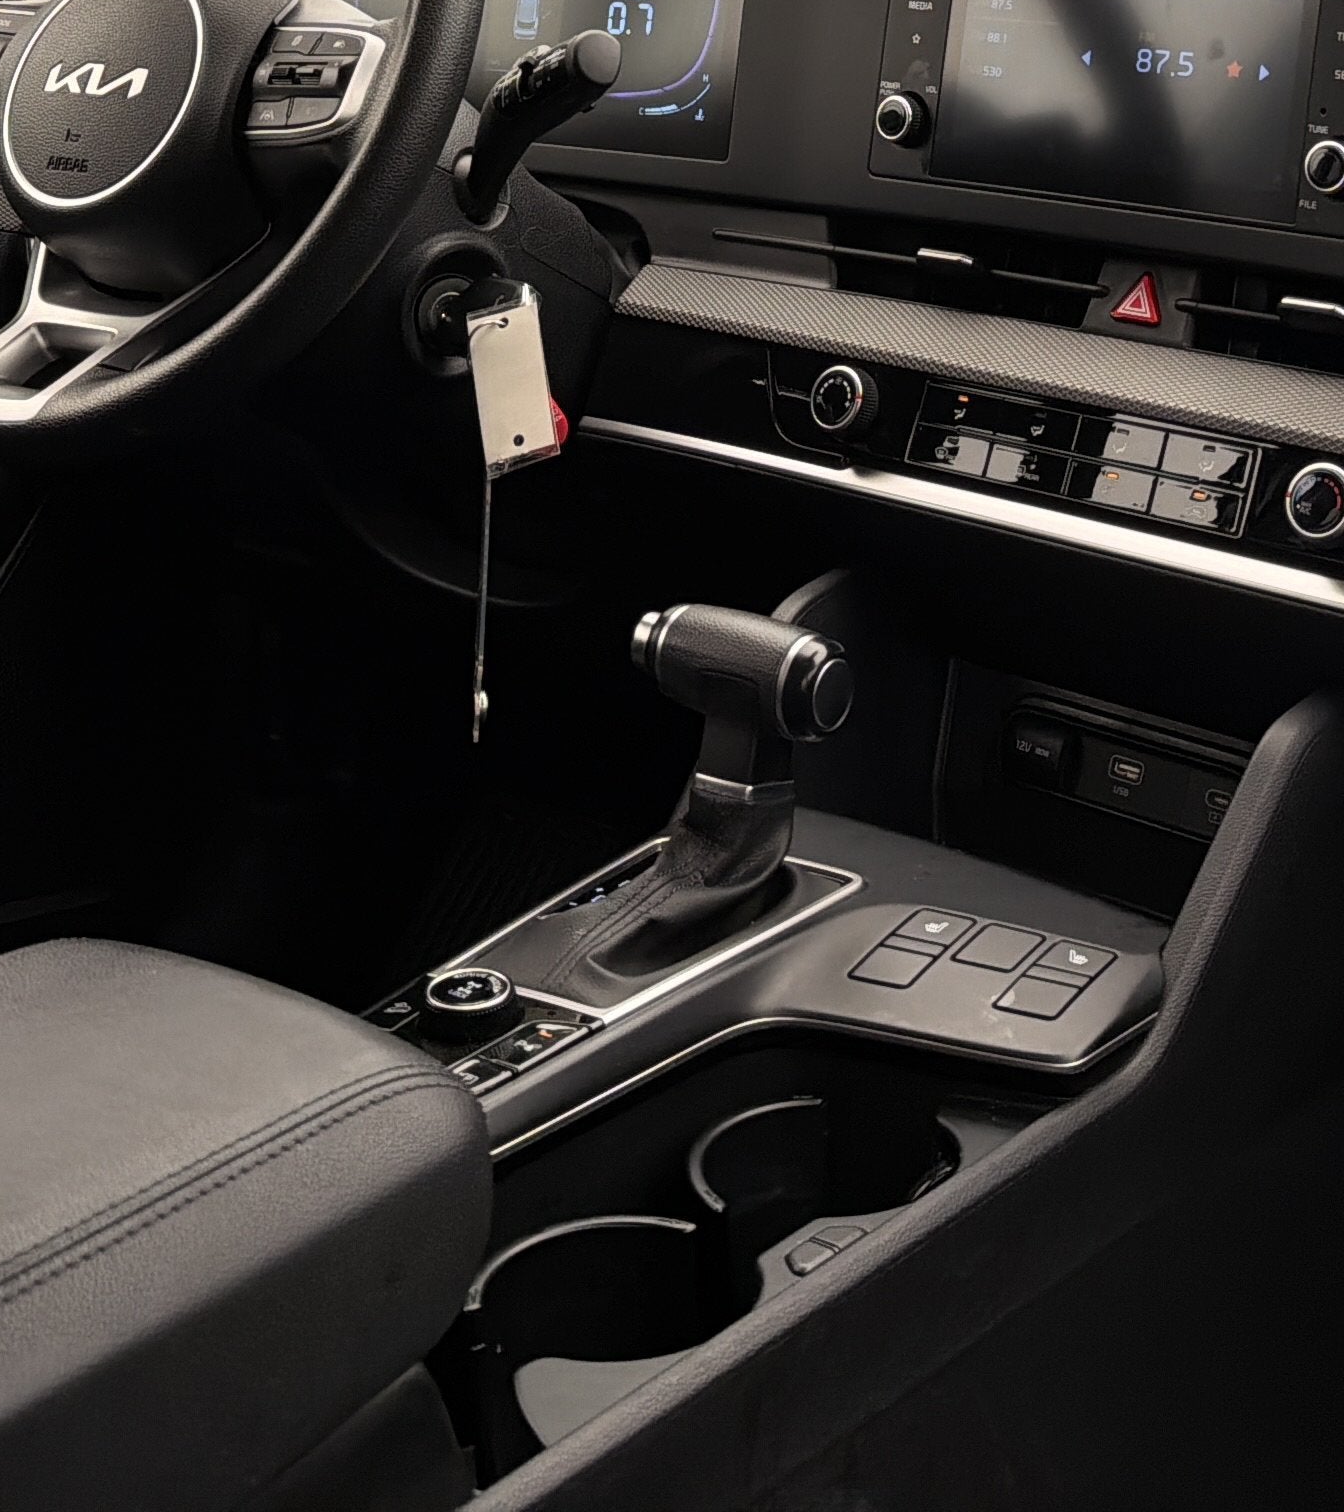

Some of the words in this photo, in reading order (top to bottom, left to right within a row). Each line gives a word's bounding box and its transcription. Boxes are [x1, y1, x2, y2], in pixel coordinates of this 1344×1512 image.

[908, 0, 933, 11] MEDIA
[606, 0, 655, 37] 0.7
[1135, 48, 1195, 78] 87.5
[982, 65, 1003, 78] 530
[43, 62, 149, 100] KIA
[925, 85, 938, 94] VOL
[1307, 123, 1329, 135] TUNE
[1298, 198, 1318, 210] FILE
[1112, 784, 1129, 798] USB
